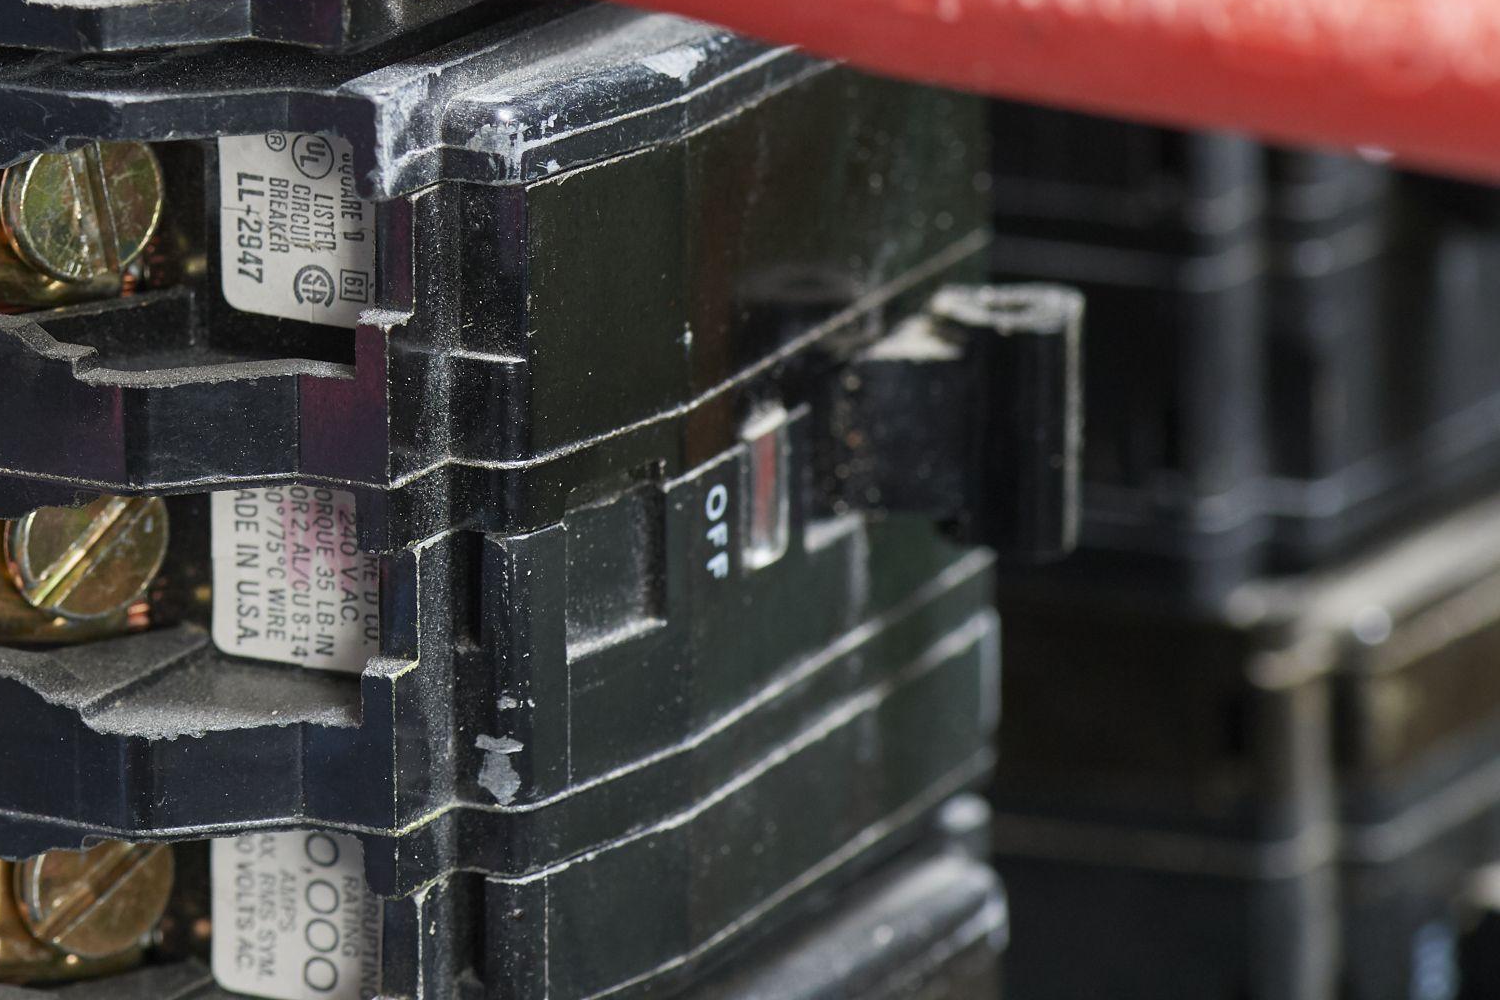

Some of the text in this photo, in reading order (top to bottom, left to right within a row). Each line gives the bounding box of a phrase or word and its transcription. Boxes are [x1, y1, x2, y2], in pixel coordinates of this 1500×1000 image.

[237, 173, 264, 283] LL-2947
[270, 177, 289, 253] BREAKER
[291, 184, 313, 252] CIRCUIT
[314, 194, 336, 251] LISTED
[343, 231, 364, 241] D
[345, 277, 363, 295] 61
[339, 511, 357, 556] 240
[706, 484, 728, 578] OFF
[234, 491, 259, 645] ADE IN U.S.A.
[291, 543, 310, 608] AL/CU
[313, 489, 334, 656] ORQUE 35 LB-IN
[267, 589, 284, 641] WIRE
[291, 613, 308, 657] 8-14
[236, 862, 254, 929] VOLTS
[260, 873, 275, 919] RMS
[281, 871, 295, 933] AMPS
[301, 833, 340, 992] 0,000
[343, 876, 358, 957] RATING
